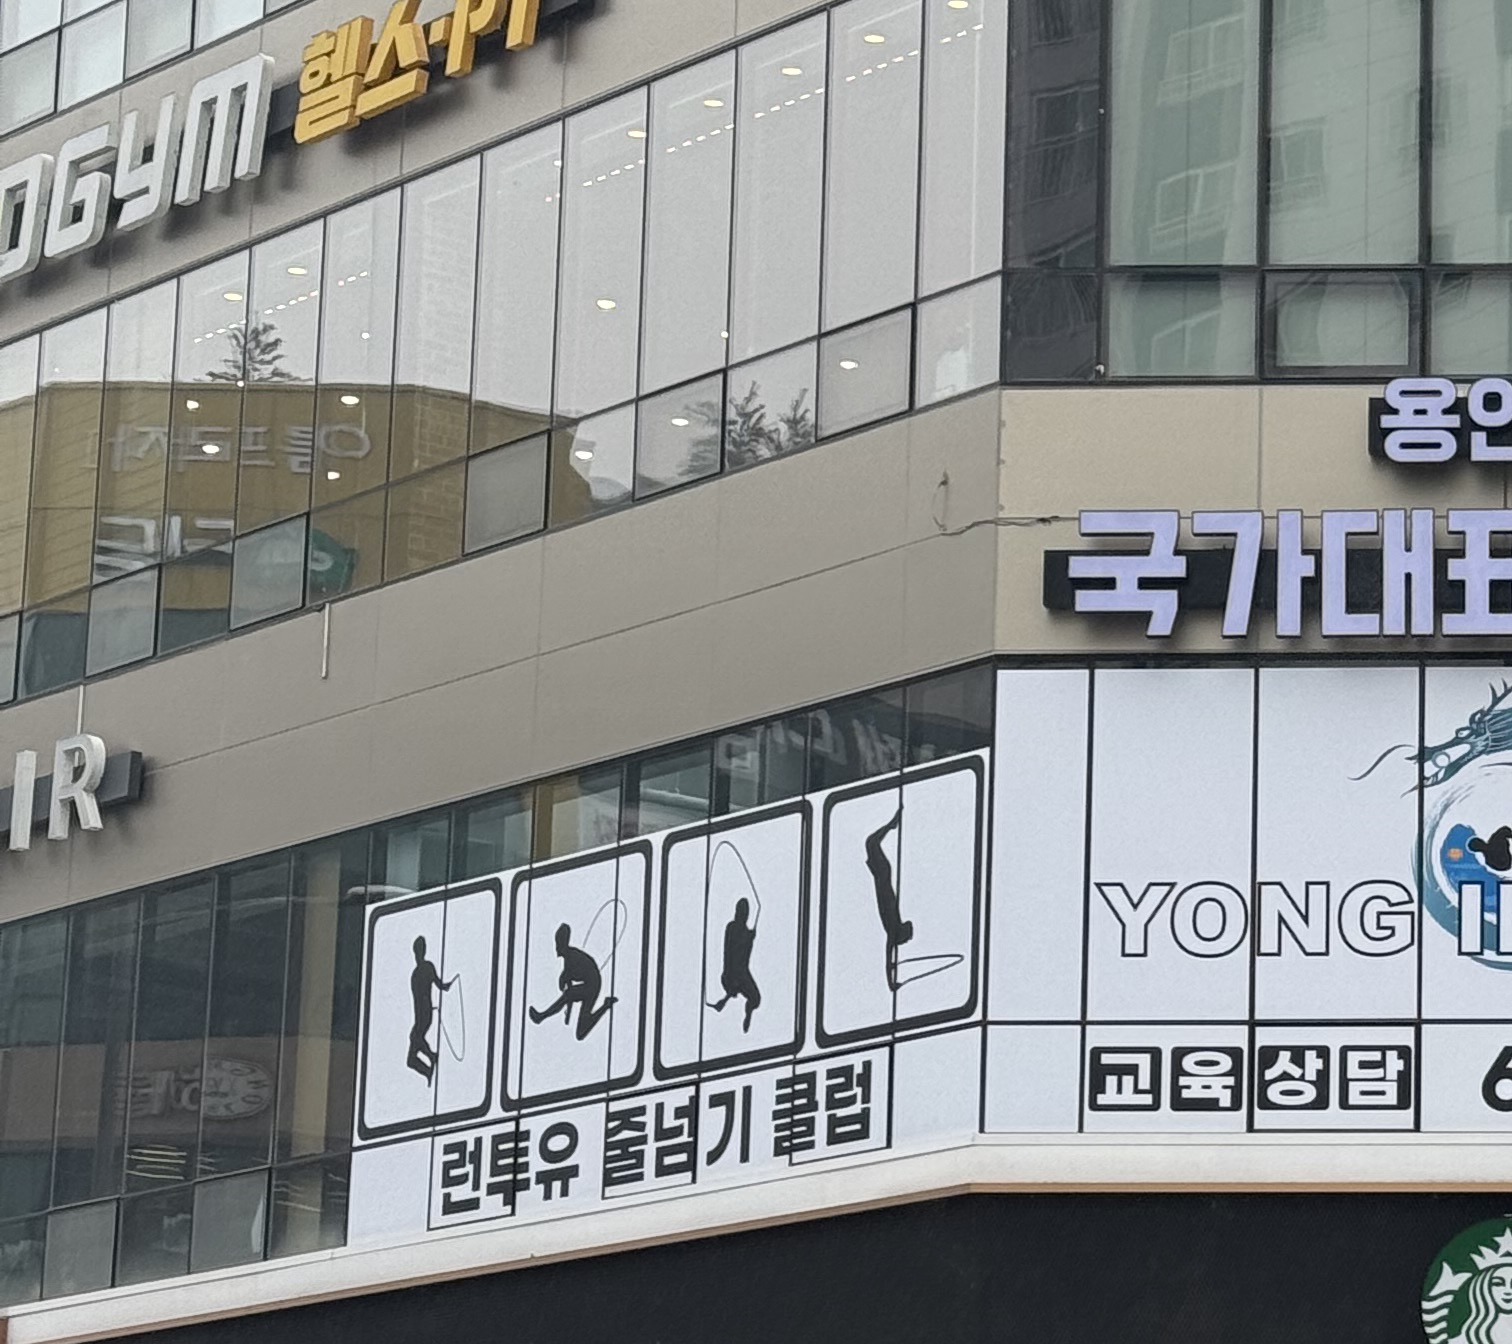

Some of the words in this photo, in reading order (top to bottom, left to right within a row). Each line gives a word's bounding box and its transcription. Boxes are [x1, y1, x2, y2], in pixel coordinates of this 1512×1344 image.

[1093, 879, 1416, 959] YONG
[1092, 1047, 1410, 1110] 교육상담
[440, 1120, 579, 1218] 런투유
[603, 1085, 753, 1189] 줄넘기
[773, 1059, 872, 1158] 클럽
